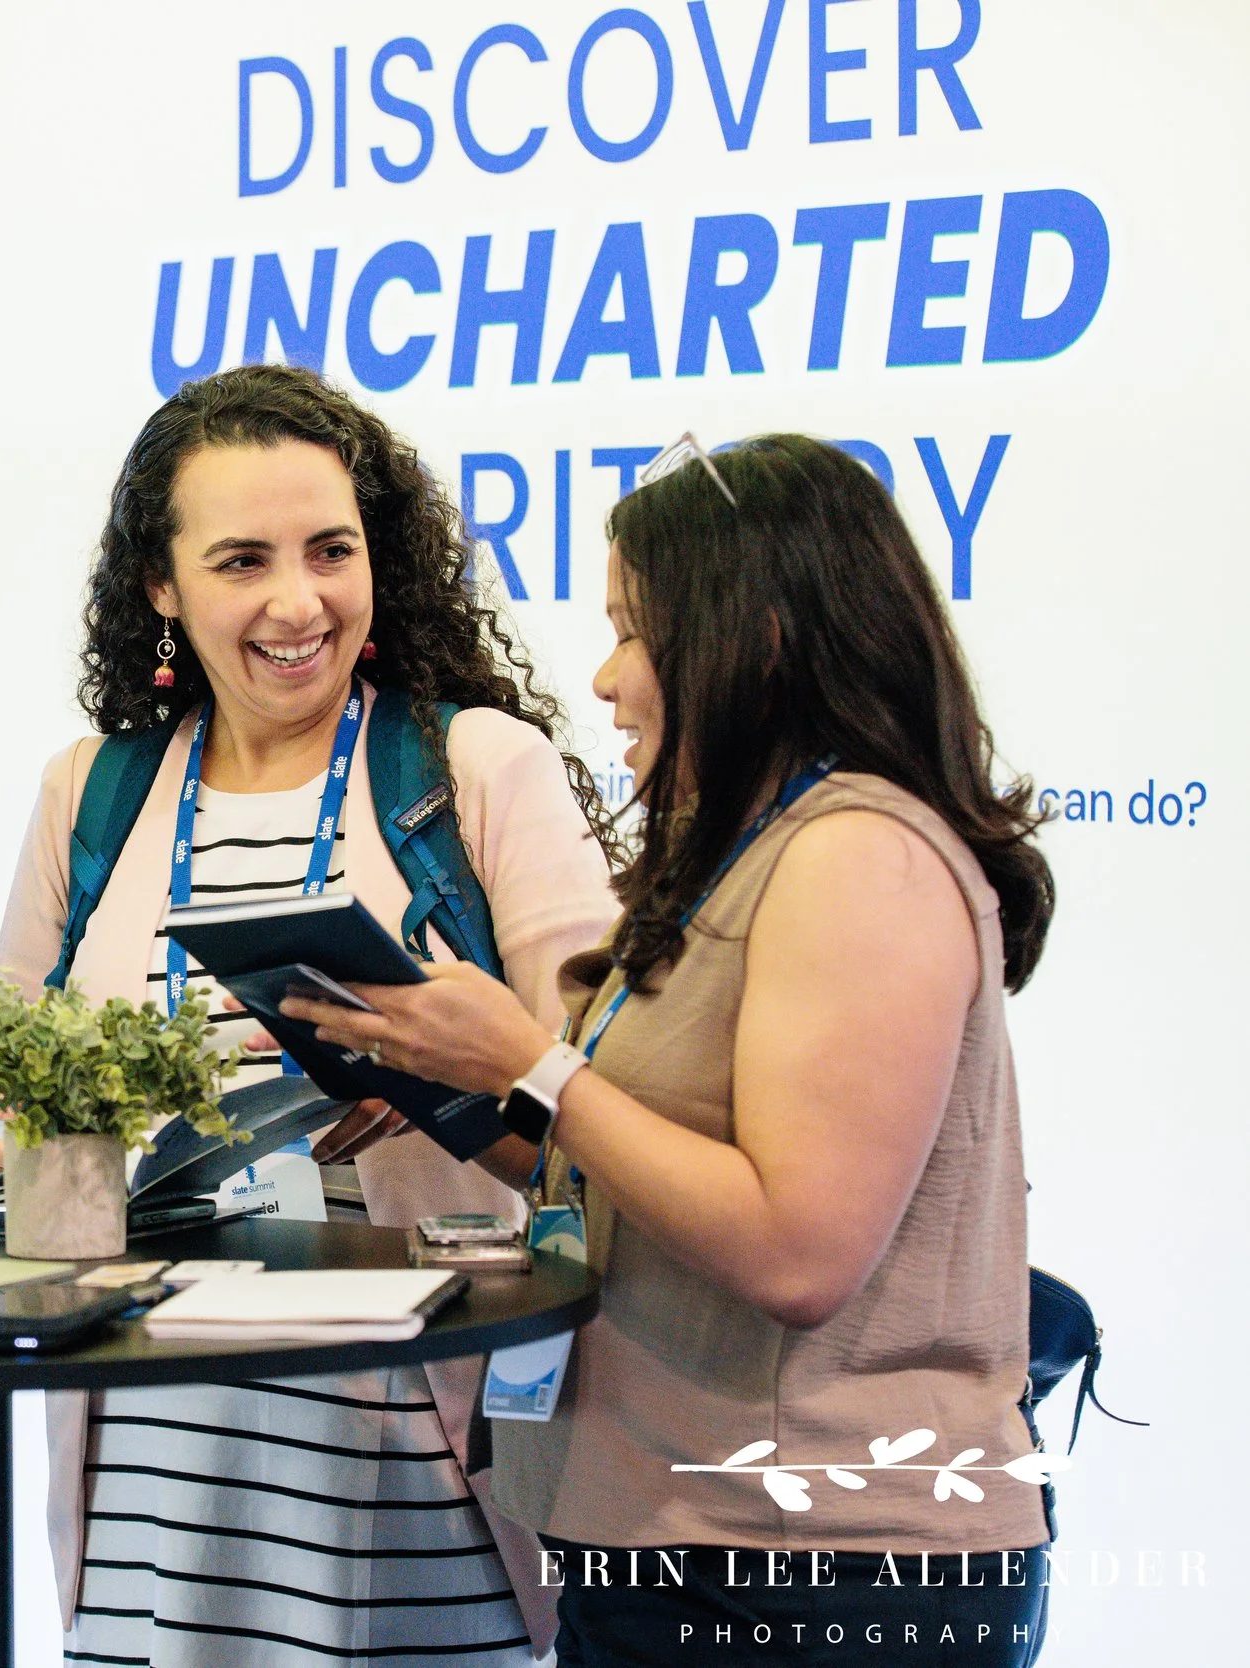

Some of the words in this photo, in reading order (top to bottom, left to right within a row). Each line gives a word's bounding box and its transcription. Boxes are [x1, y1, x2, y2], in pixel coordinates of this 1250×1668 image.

[238, 0, 983, 197] DISCOVER
[151, 188, 1111, 402] UNCHARTED
[344, 697, 361, 721] slate
[330, 755, 348, 779] slate
[183, 777, 196, 801] slate
[407, 792, 448, 828] patagonia
[1038, 788, 1113, 822] can
[1129, 779, 1207, 827] do?
[320, 815, 335, 841] slate
[175, 839, 190, 864] slate
[307, 880, 321, 896] ate
[170, 972, 183, 1000] slate
[231, 1185, 249, 1196] slate
[249, 1180, 276, 1193] summit
